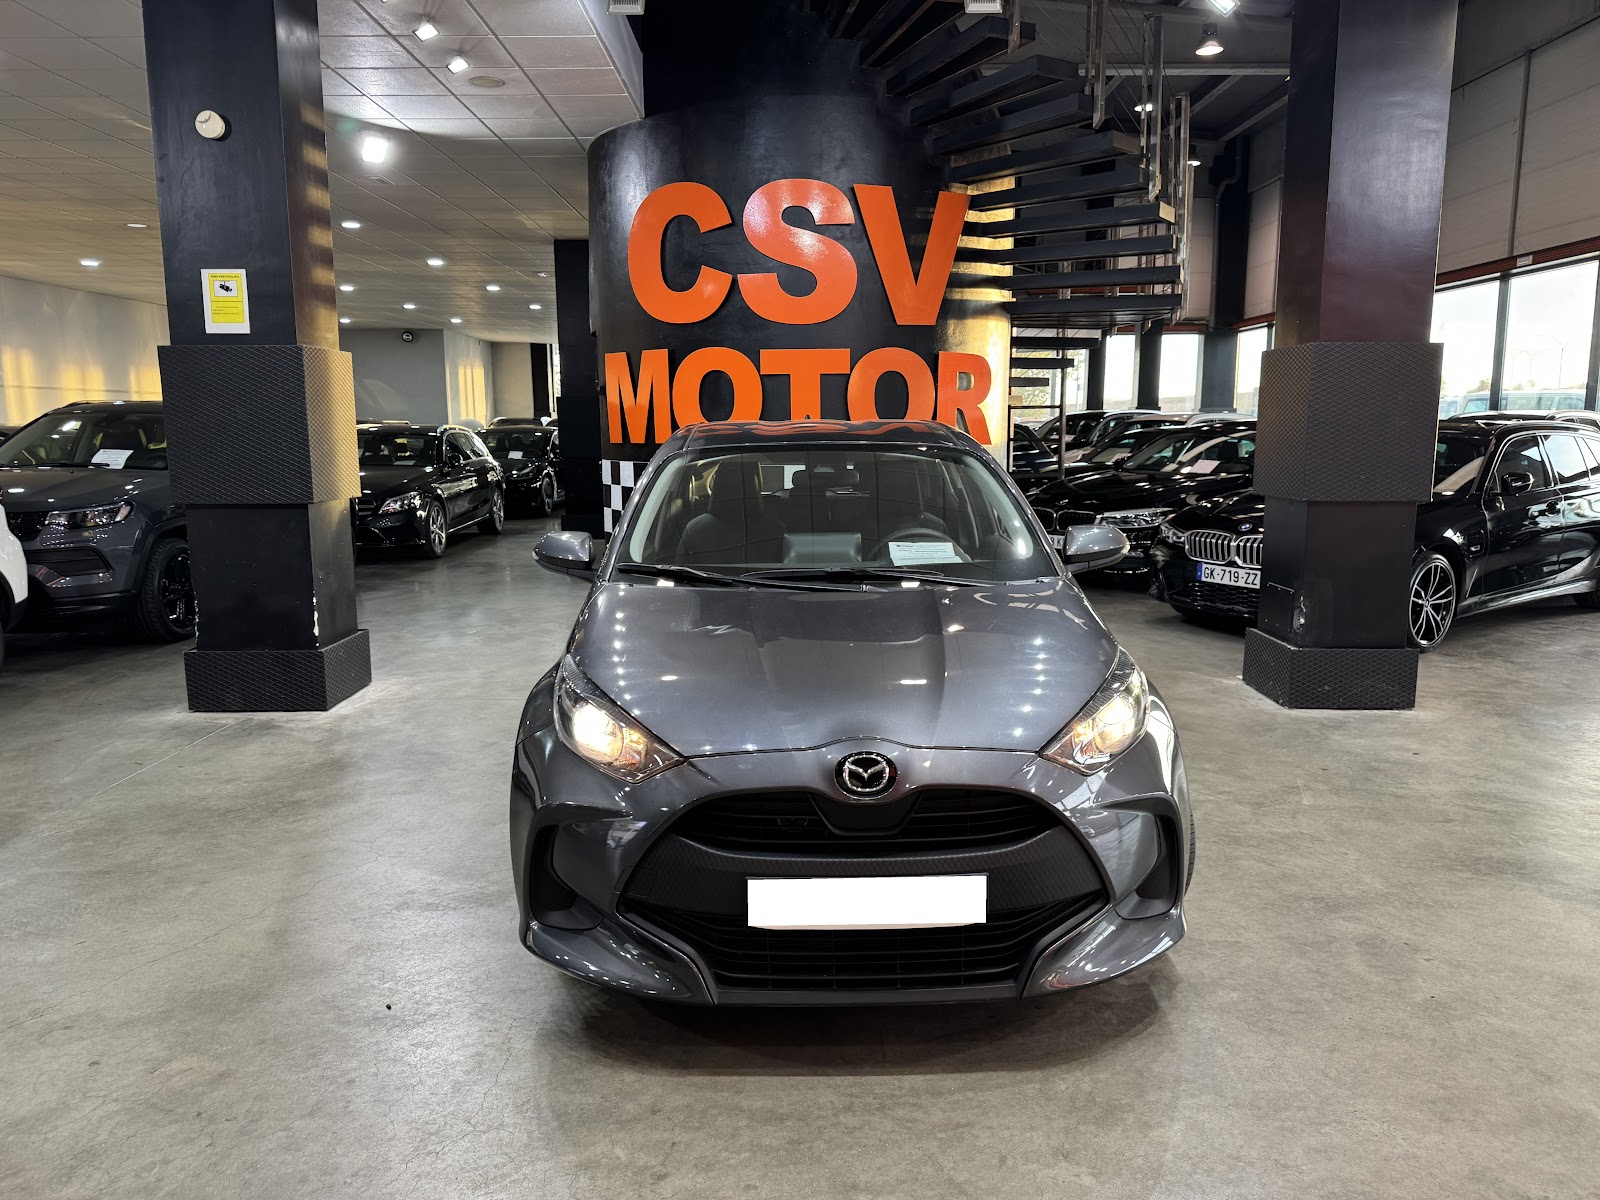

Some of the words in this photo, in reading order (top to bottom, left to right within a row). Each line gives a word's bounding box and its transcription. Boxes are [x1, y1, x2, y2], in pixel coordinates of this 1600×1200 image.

[627, 178, 971, 325] CSV
[604, 346, 992, 445] MOTOR
[1203, 566, 1258, 586] GK-719-ZZ
